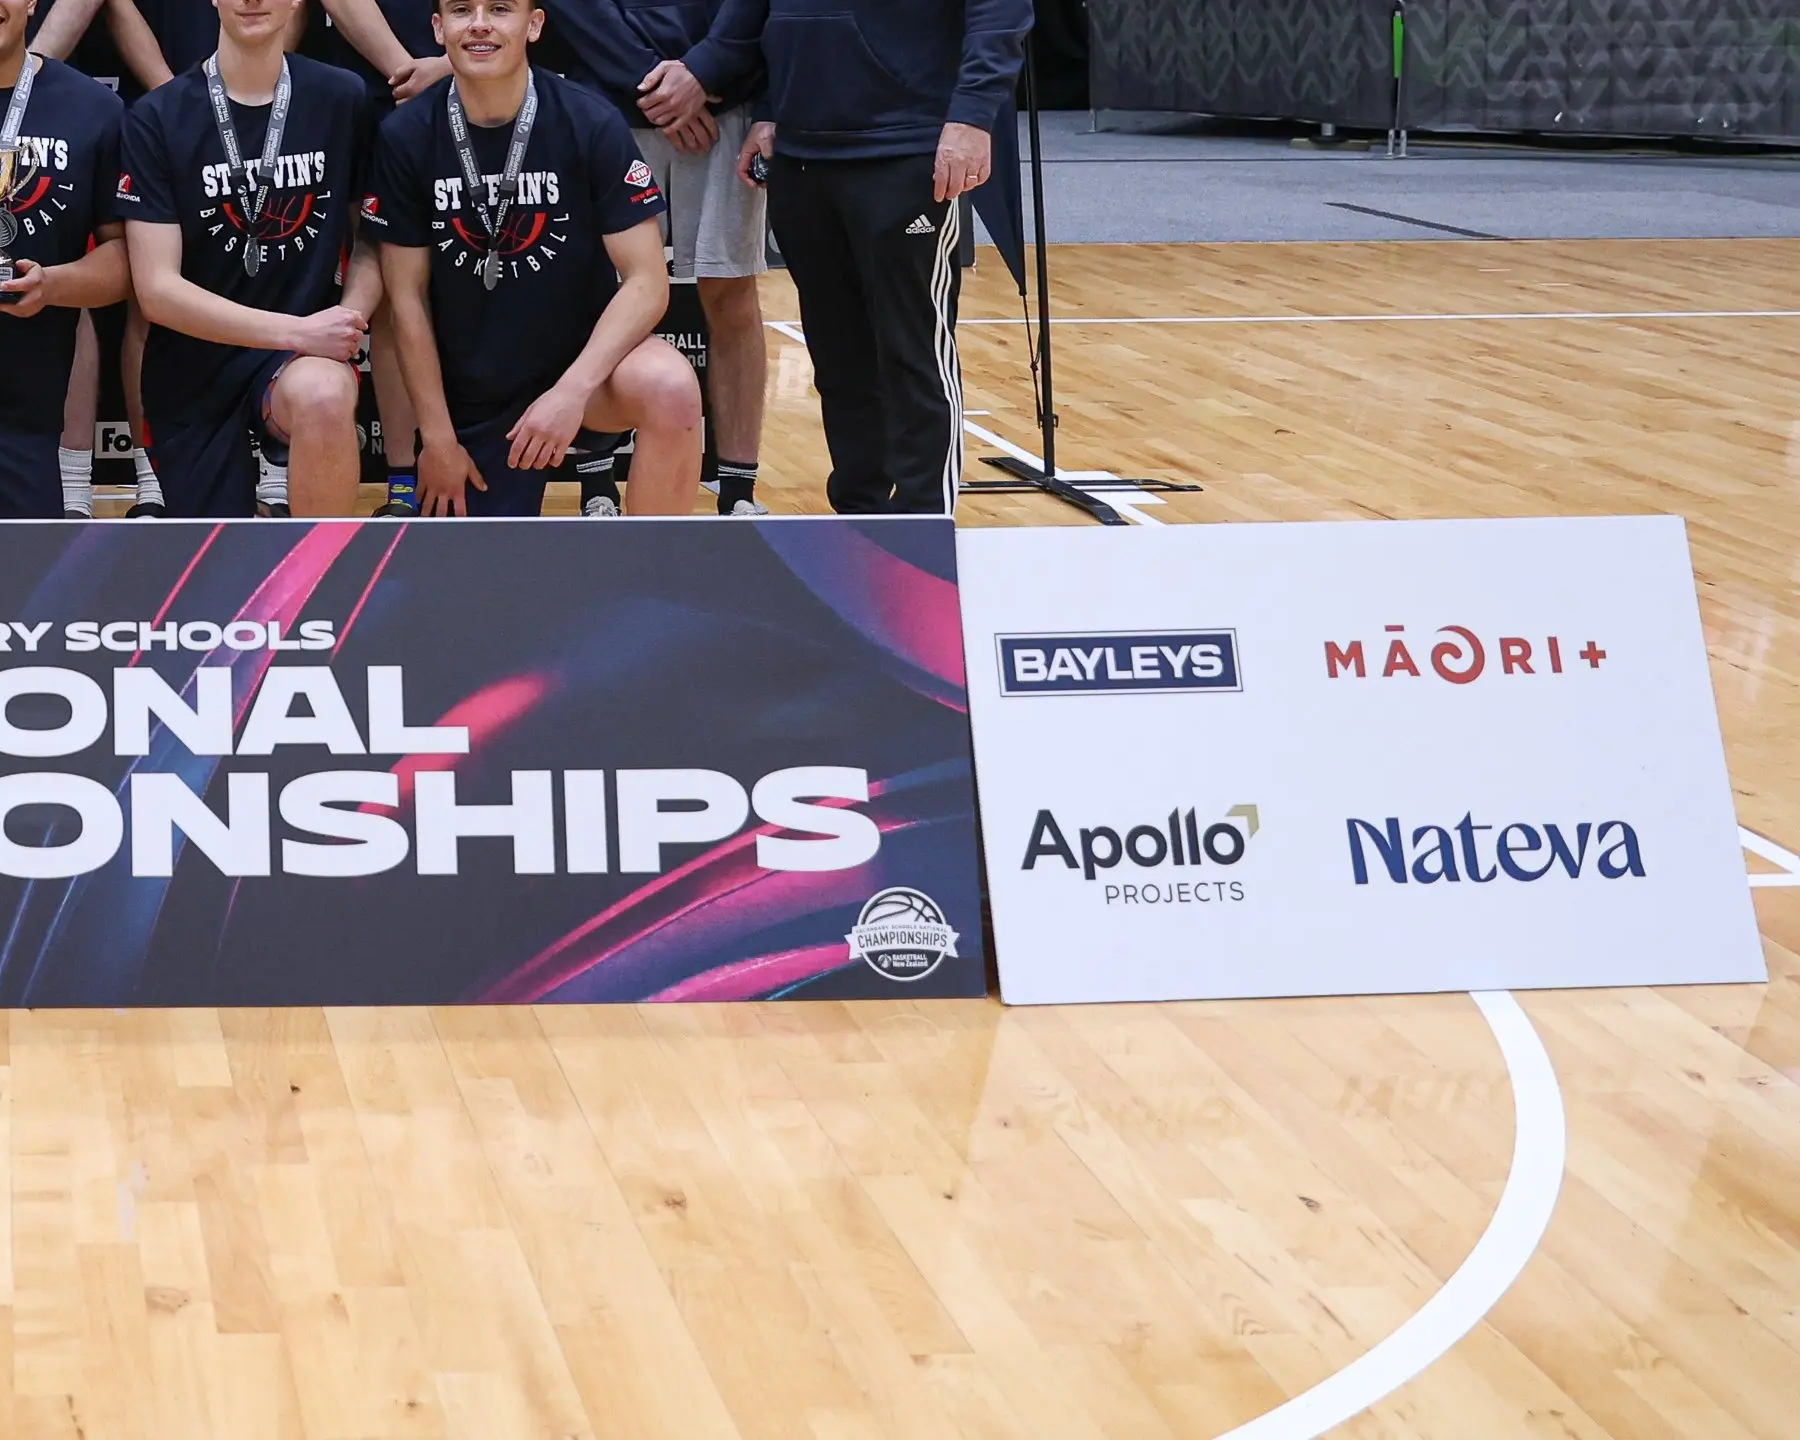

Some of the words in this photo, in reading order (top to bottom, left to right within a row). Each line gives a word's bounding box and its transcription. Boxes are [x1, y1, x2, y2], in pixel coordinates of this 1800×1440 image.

[202, 163, 232, 198] ST
[434, 178, 462, 211] ST
[200, 191, 331, 262] BASETBALL
[905, 224, 937, 235] adidas
[64, 620, 336, 651] SCHOOLS
[1014, 643, 1223, 682] BAYLEYS
[1021, 806, 1246, 881] Apollo
[1345, 810, 1647, 885] Nateva
[1105, 882, 1245, 905] PROJECTS
[857, 930, 947, 948] CHAMPIONSHIPS
[892, 953, 927, 961] BASKETBALL
